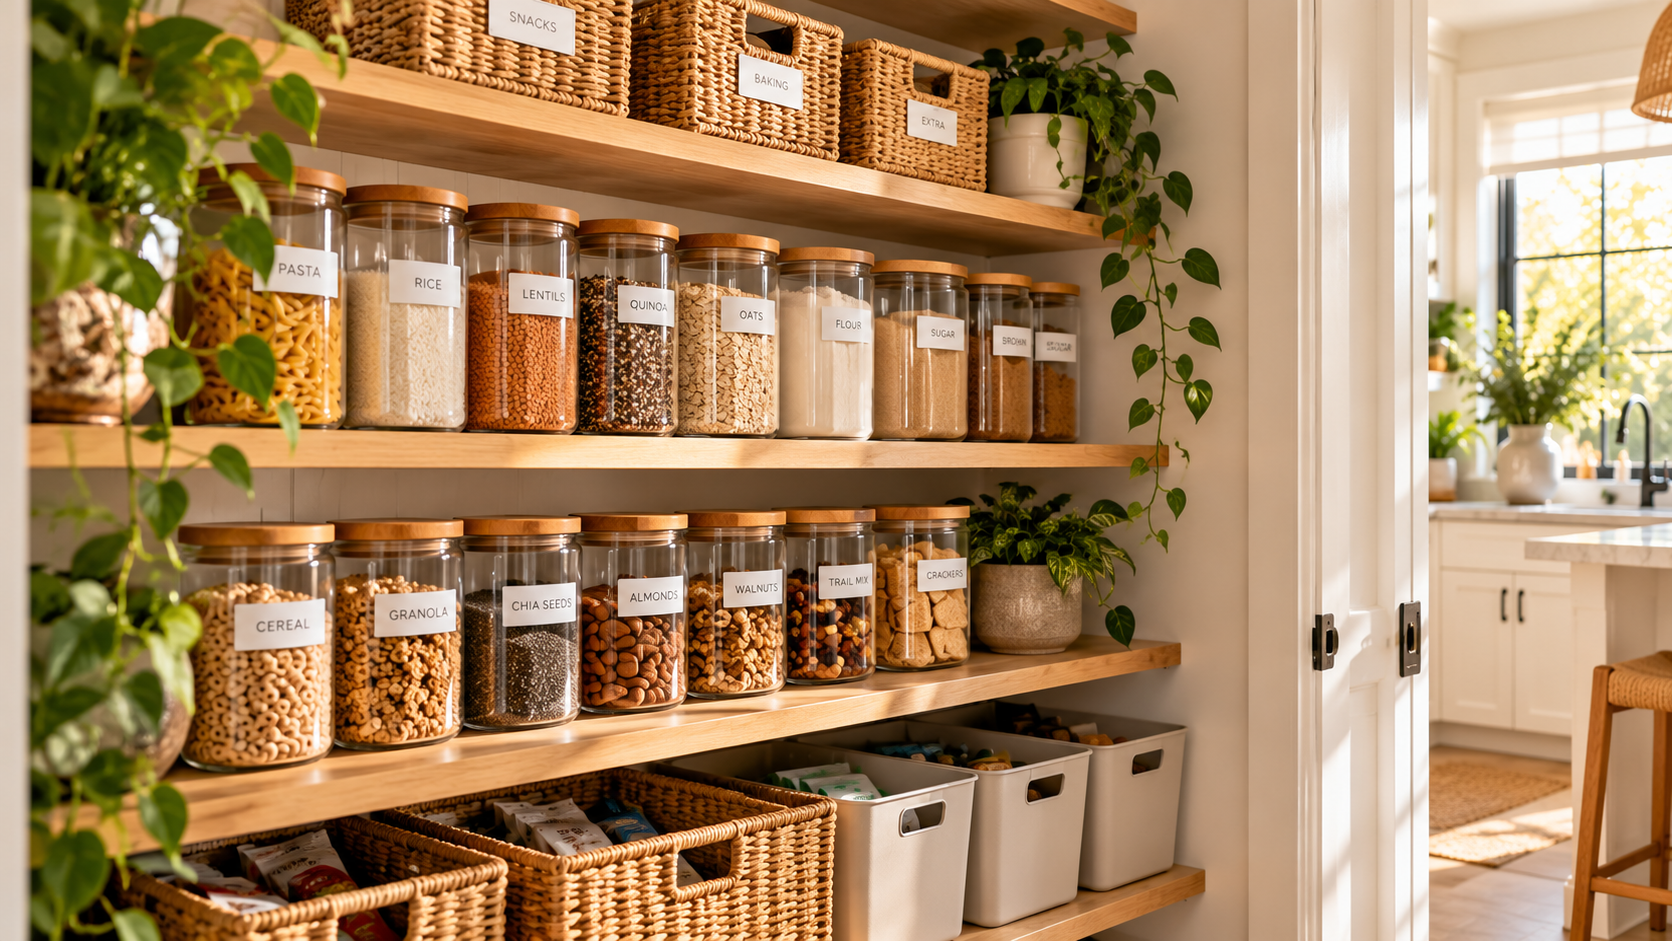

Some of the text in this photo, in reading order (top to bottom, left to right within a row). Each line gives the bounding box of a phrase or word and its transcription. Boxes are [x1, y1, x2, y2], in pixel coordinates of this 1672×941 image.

[509, 10, 557, 33] SNACKS
[754, 73, 789, 91] BAKING
[921, 116, 946, 130] EXTRA
[278, 263, 321, 278] PASTA
[415, 277, 442, 290] RICE
[522, 289, 566, 302] LENTILS
[630, 300, 667, 312] QUINOA
[739, 310, 763, 321] OATS
[835, 319, 861, 330] FLOUR
[931, 328, 955, 339] SUGAR
[829, 576, 869, 586] TRAIL MIX
[927, 569, 964, 580] CRACKERS
[735, 583, 779, 594] WALNUTS
[630, 590, 678, 603] ALMONDS
[511, 597, 572, 611] CHIA SEEDS
[388, 606, 449, 622] GRANOLA
[256, 619, 310, 633] CEREAL
